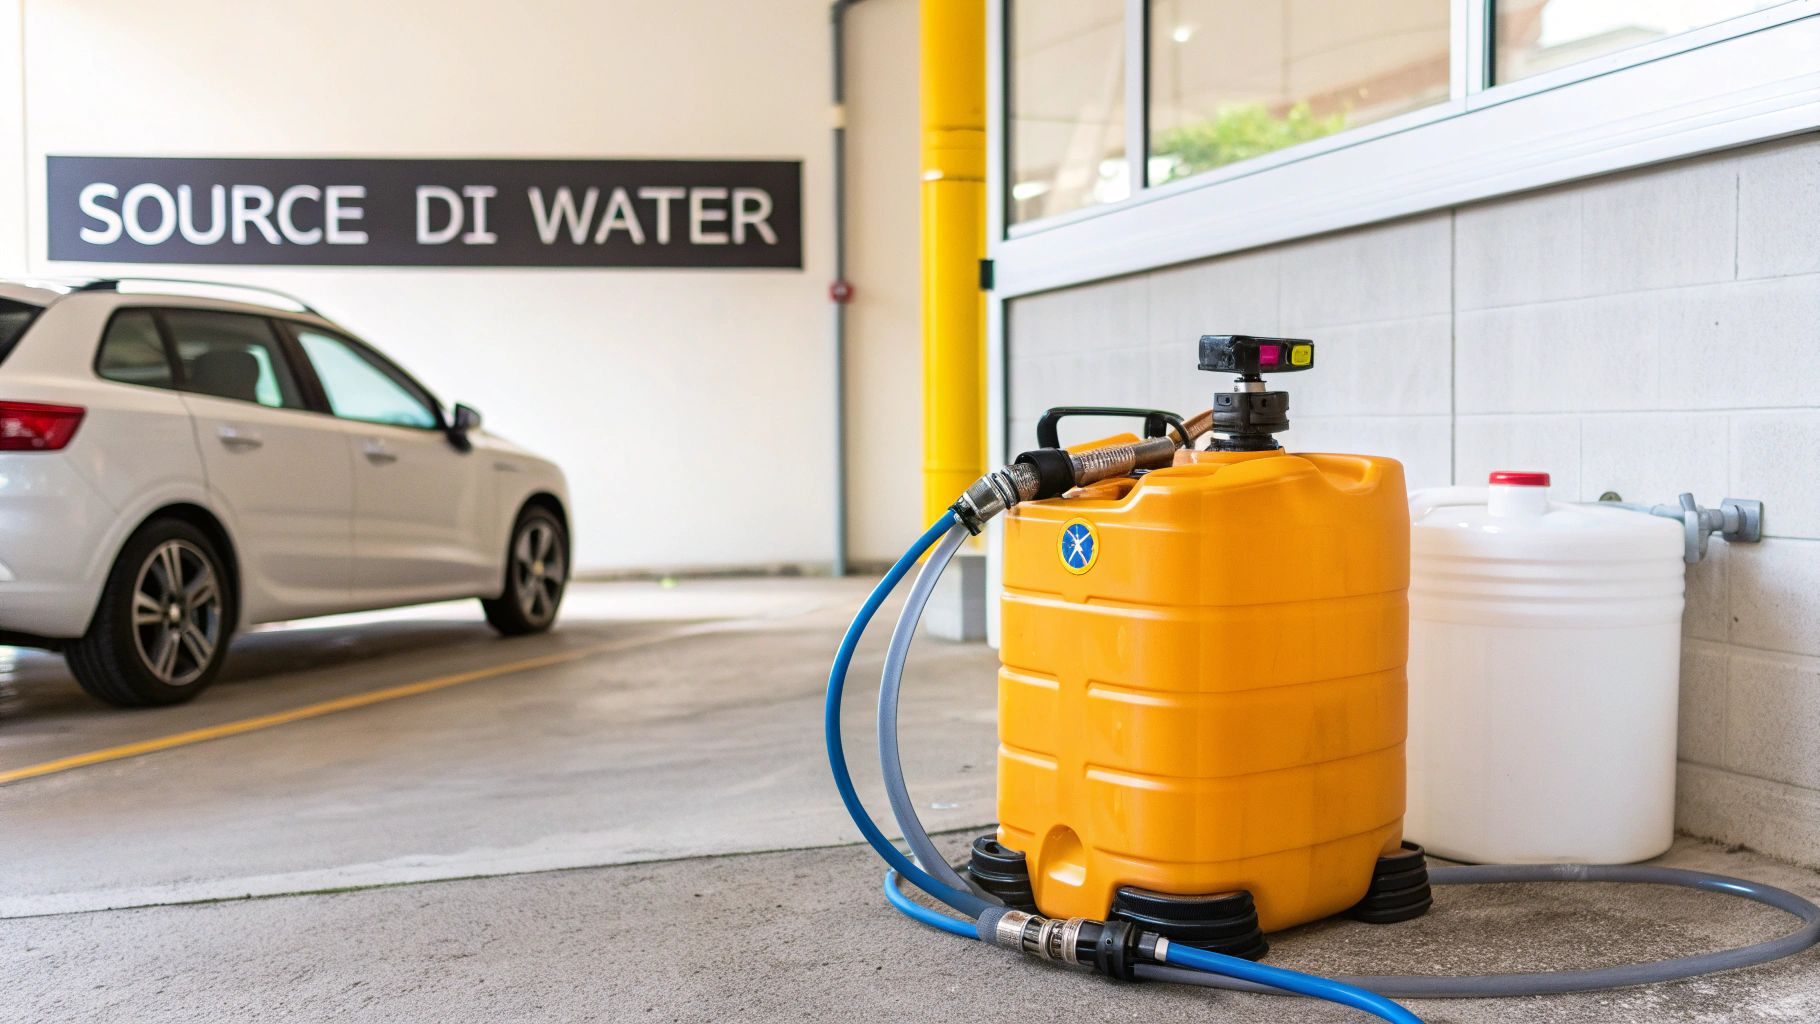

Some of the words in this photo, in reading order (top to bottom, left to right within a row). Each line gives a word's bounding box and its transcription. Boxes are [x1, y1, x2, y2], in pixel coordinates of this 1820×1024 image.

[78, 182, 369, 246] SOURCE
[416, 185, 498, 245] DI
[528, 187, 779, 245] WATER
